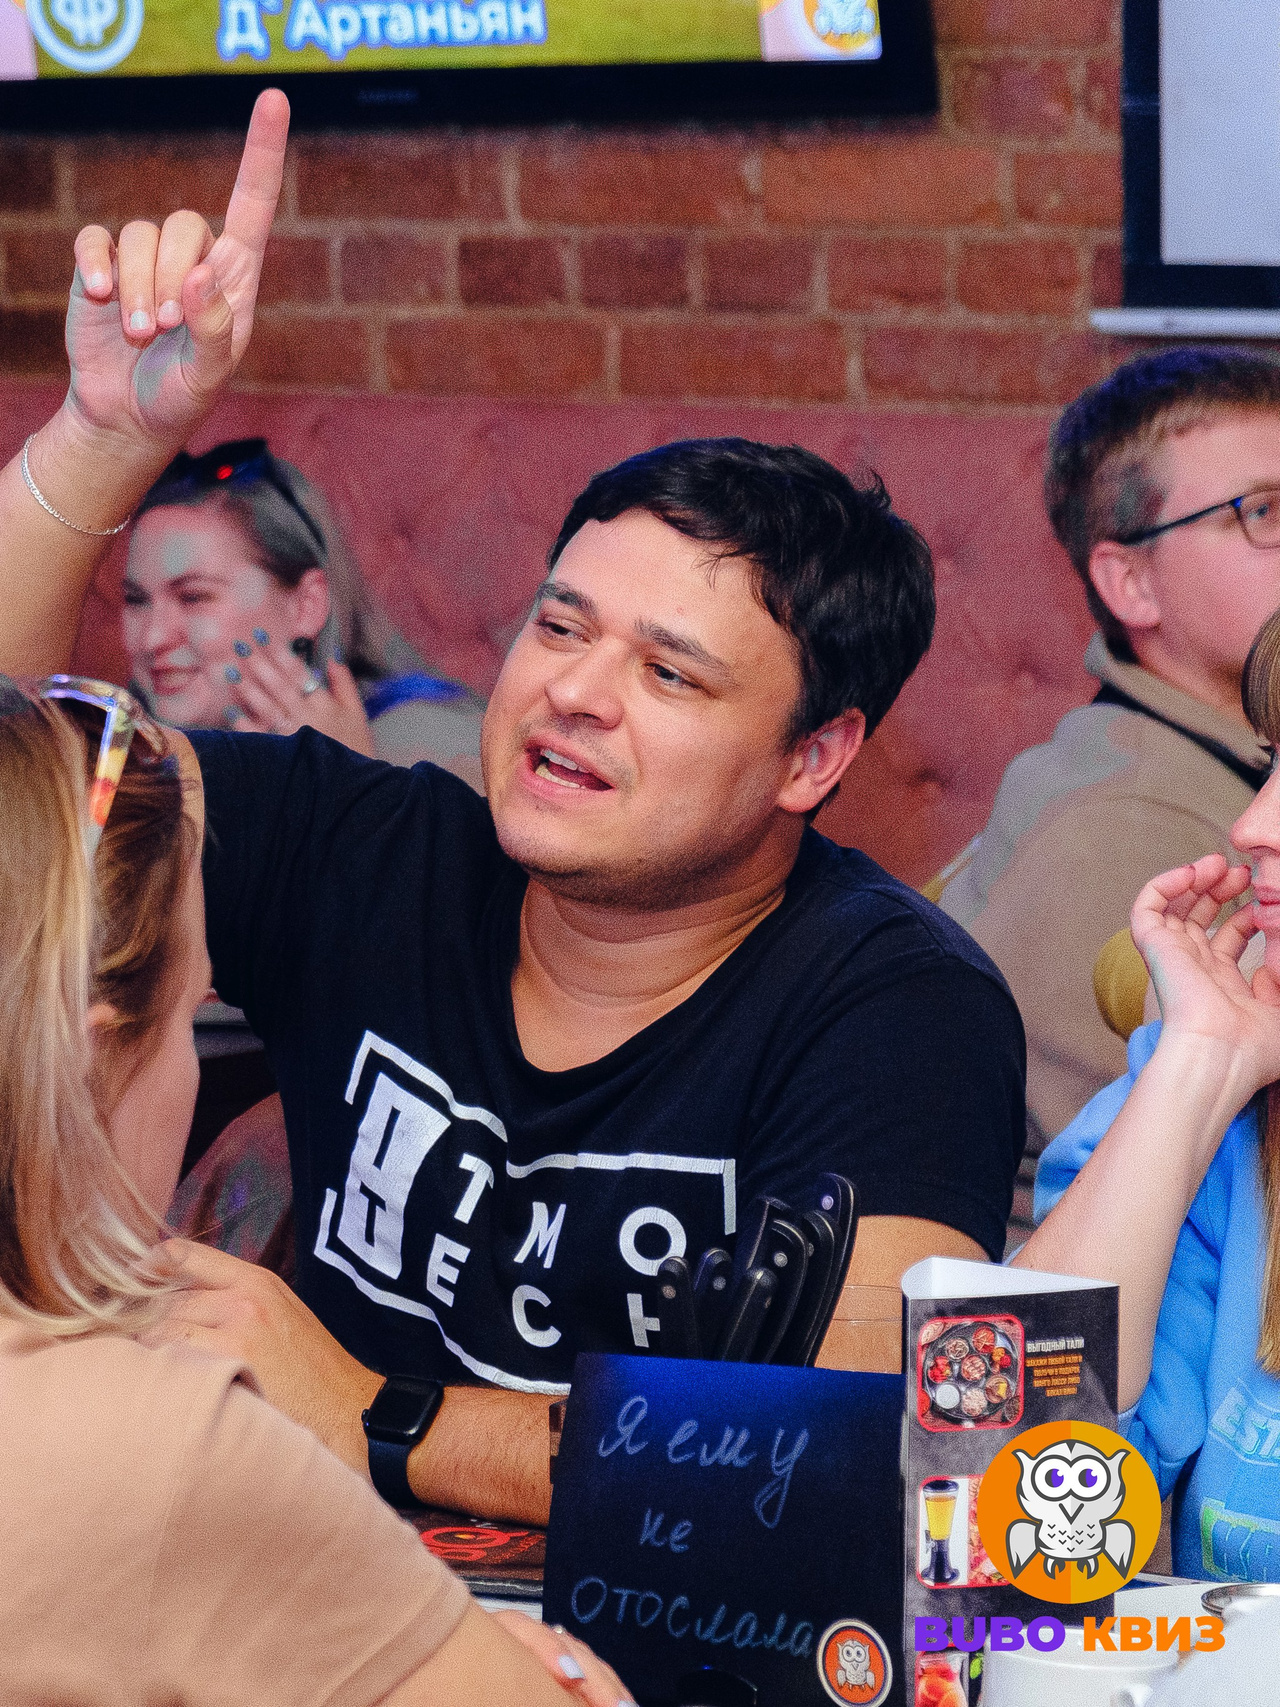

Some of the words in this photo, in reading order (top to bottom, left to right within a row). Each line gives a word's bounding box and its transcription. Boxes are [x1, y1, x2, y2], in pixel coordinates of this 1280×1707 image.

[286, 0, 546, 60] Артаньян
[1026, 1338, 1066, 1353] ВЫГОДНЫЙ
[598, 1395, 649, 1457] Я
